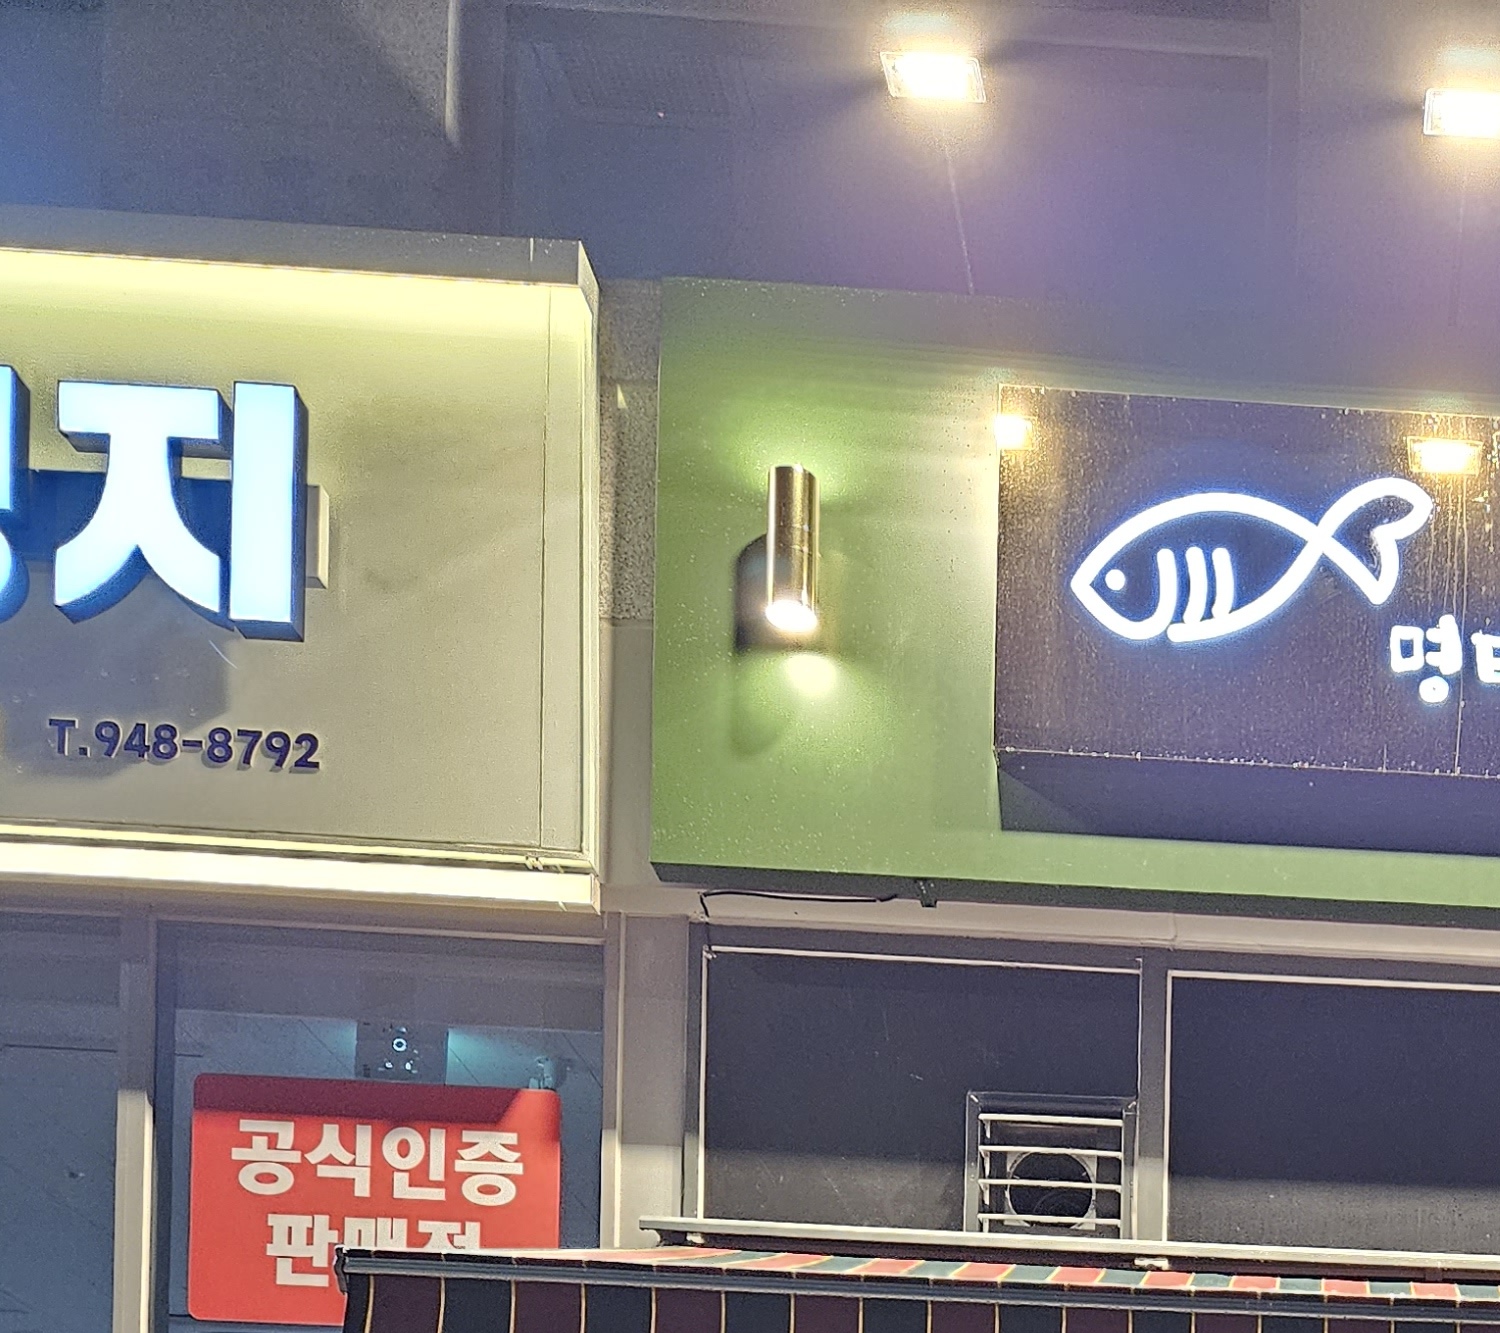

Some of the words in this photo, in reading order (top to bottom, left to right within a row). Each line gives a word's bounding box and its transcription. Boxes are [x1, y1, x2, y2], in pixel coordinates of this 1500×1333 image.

[0, 364, 303, 634] 지
[49, 718, 320, 771] T.948-8792
[231, 1119, 524, 1206] 공식인증
